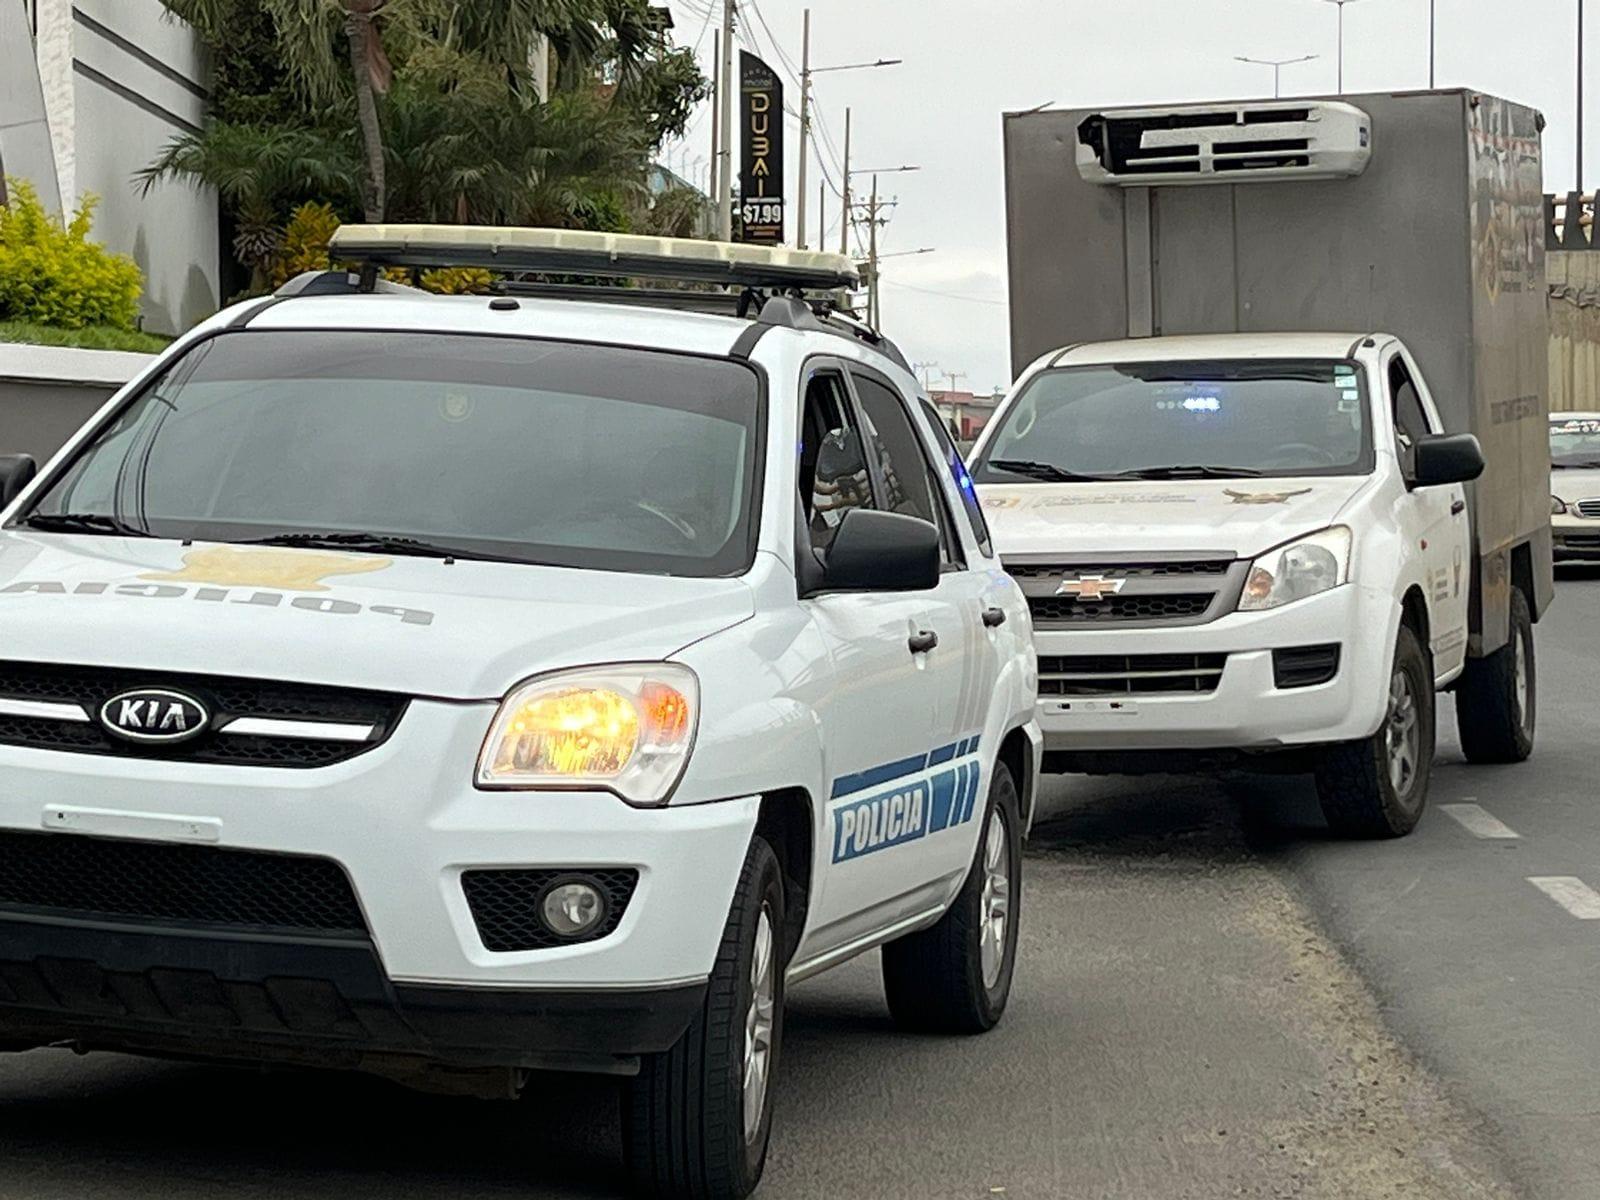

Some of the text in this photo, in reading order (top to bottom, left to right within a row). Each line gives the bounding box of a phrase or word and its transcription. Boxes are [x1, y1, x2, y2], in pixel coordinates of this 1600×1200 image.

[751, 93, 770, 197] DUBAI
[742, 204, 782, 224] $7.99
[118, 700, 187, 731] KIA
[837, 788, 924, 858] POLICIA
